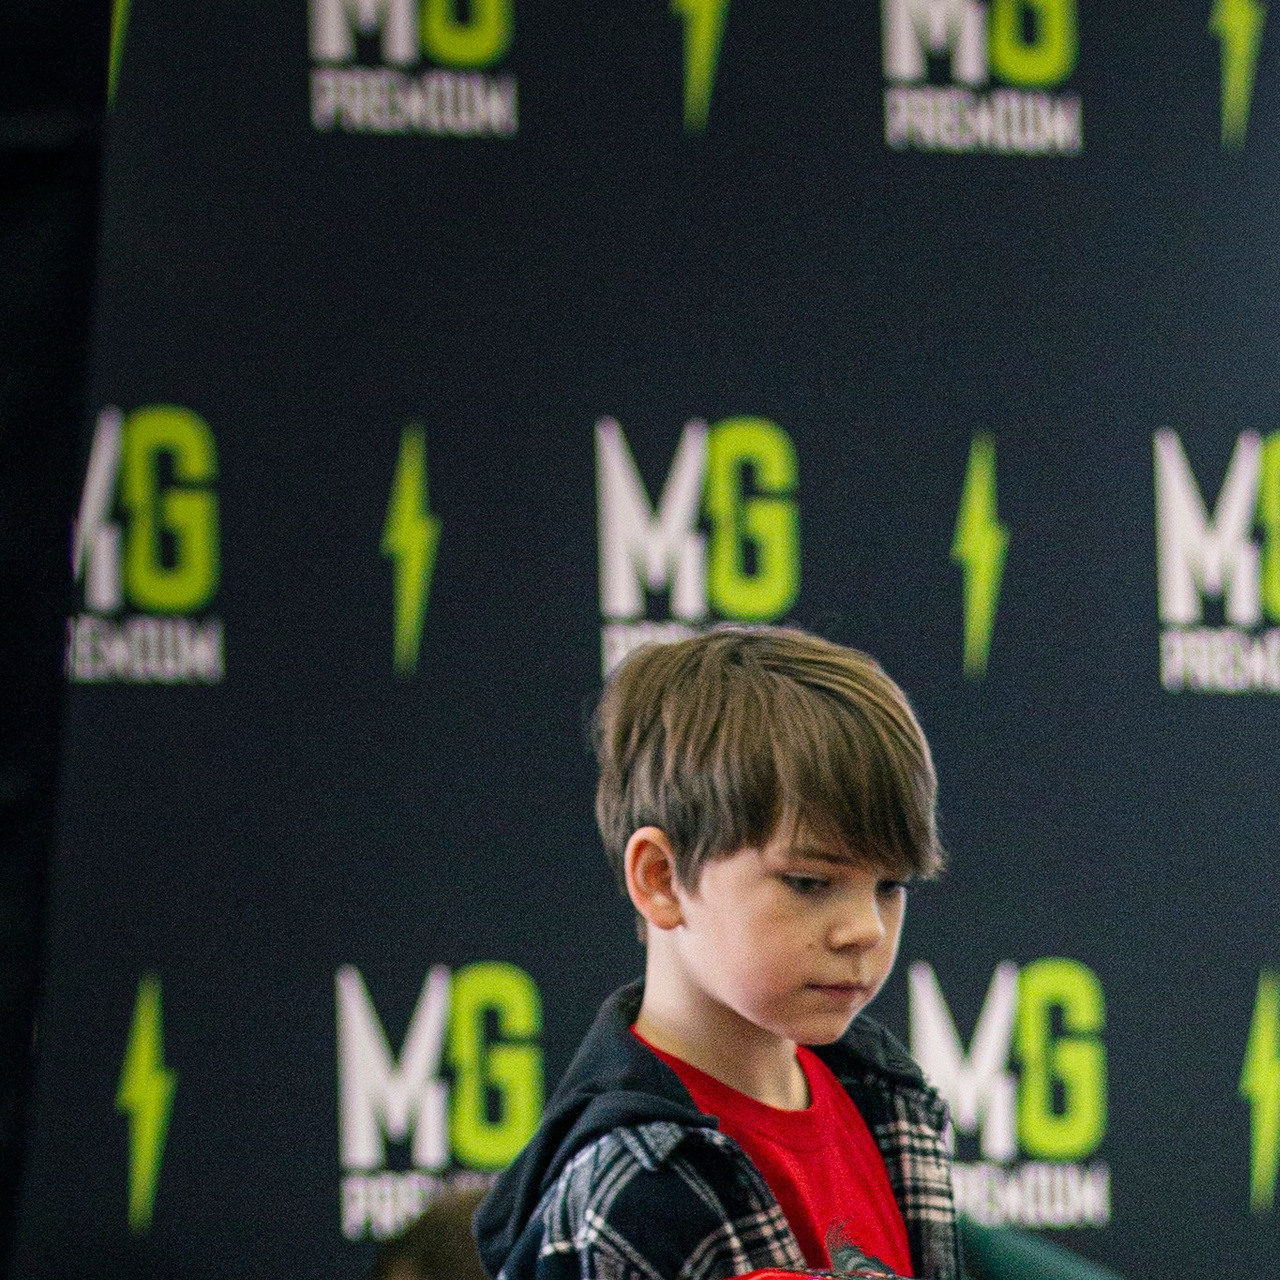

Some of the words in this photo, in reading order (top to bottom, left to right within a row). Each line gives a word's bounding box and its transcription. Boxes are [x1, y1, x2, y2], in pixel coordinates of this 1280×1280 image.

[595, 415, 800, 620] MG
[335, 961, 544, 1170] MG
[908, 957, 1105, 1160] MG
